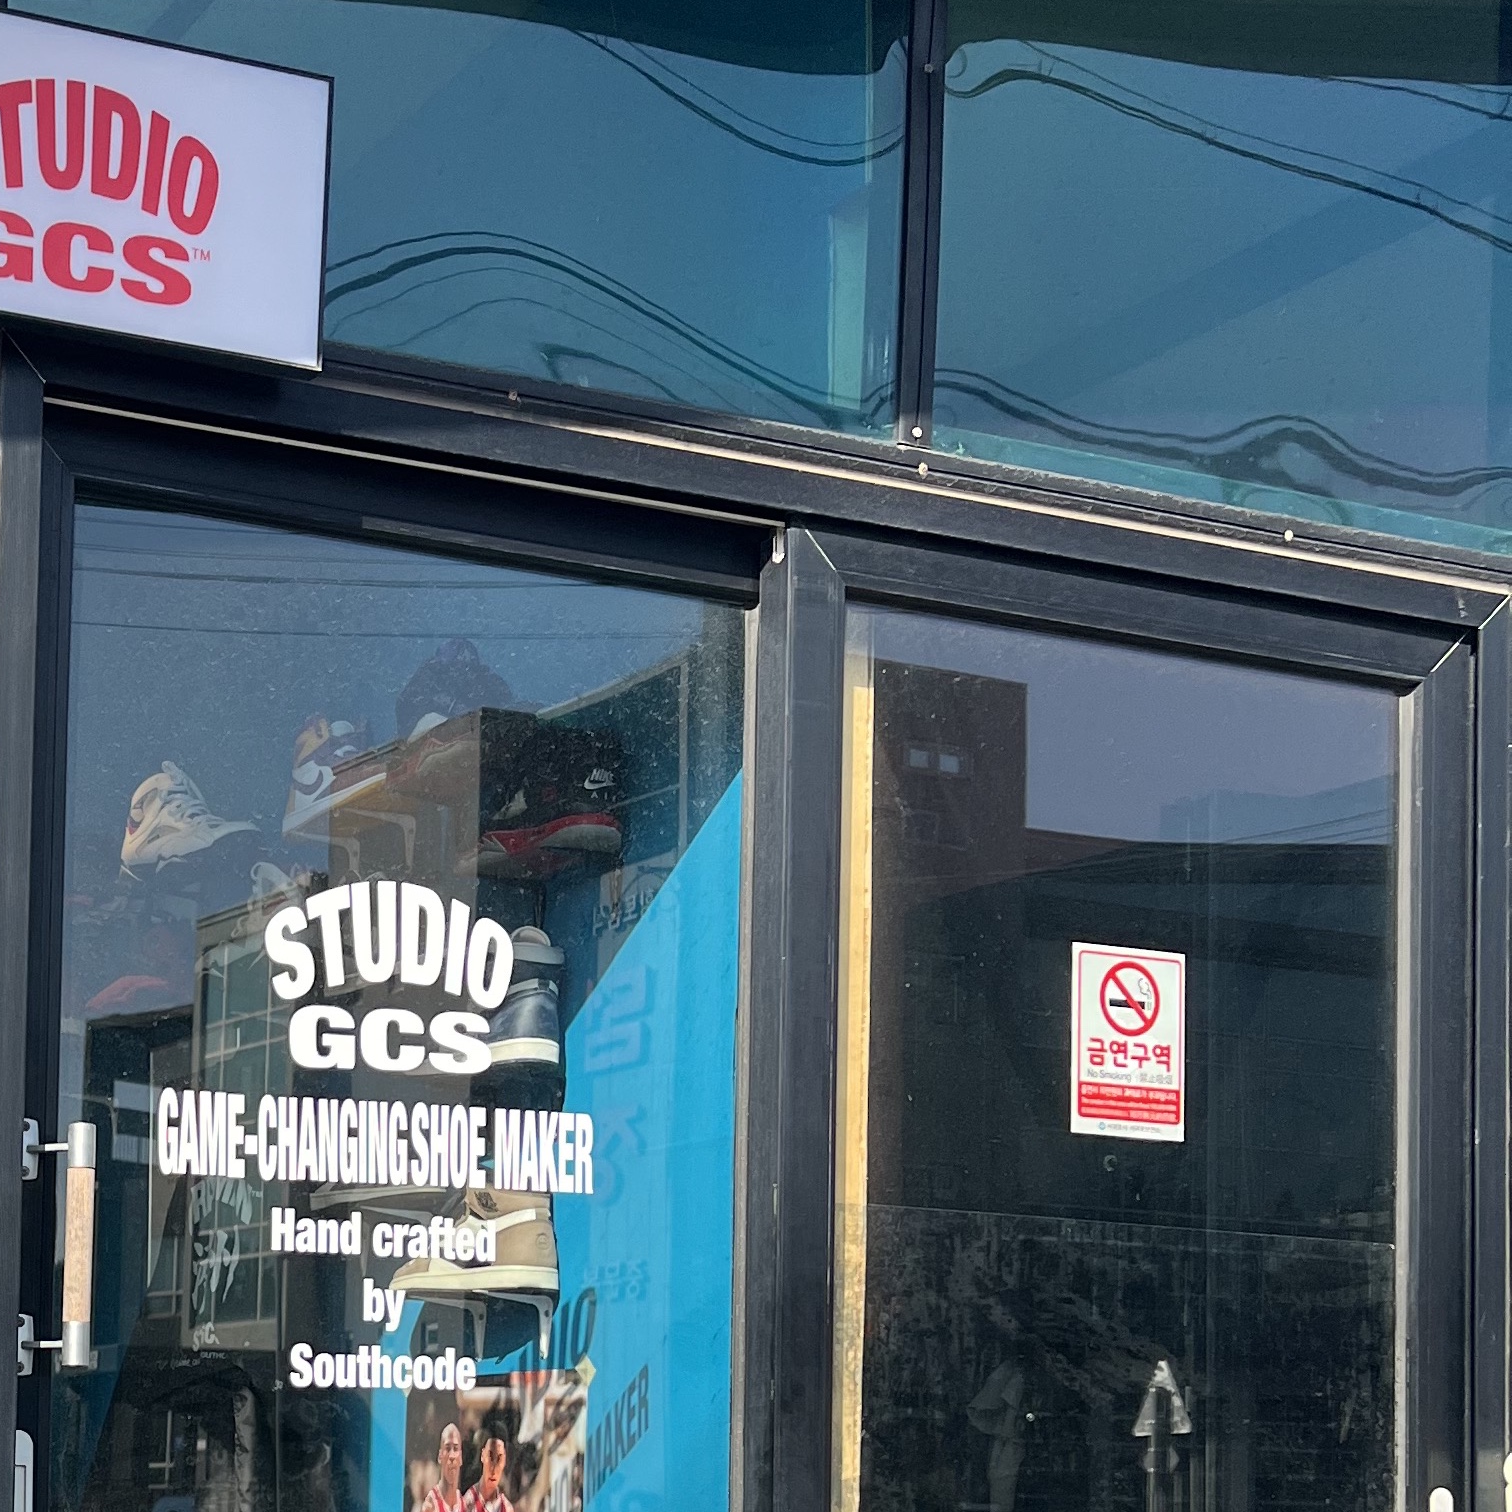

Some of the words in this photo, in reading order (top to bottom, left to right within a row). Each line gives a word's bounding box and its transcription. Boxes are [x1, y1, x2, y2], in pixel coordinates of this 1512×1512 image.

[264, 880, 514, 1009] STUDIO
[289, 1005, 492, 1074] GCS
[1086, 1037, 1171, 1073] 금연구역
[1087, 1068, 1098, 1078] No
[158, 1087, 408, 1185] GAME-CHANGING
[410, 1102, 486, 1189] SHOE
[494, 1108, 593, 1194] MAKER
[271, 1208, 361, 1255] Hand
[373, 1217, 496, 1263] crafted
[363, 1278, 405, 1332] by
[289, 1343, 477, 1391] Southcode
